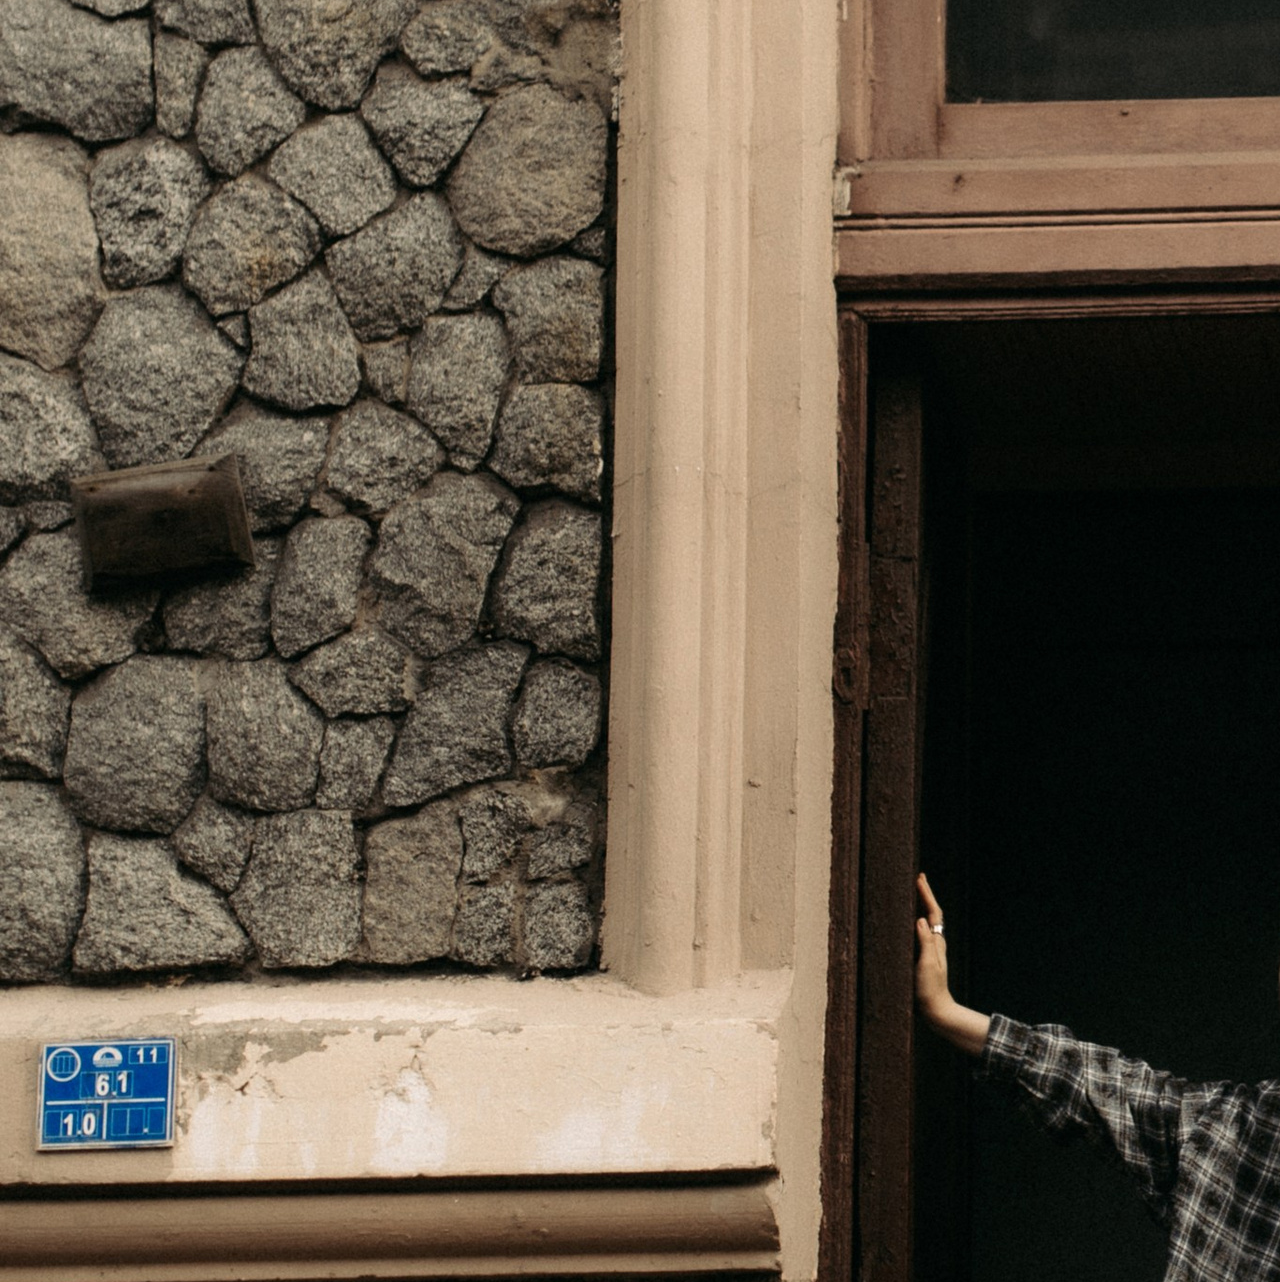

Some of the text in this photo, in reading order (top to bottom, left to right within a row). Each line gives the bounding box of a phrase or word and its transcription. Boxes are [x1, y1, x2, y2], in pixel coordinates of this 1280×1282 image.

[136, 1047, 158, 1064] 11
[95, 1071, 129, 1096] 6.1
[63, 1113, 97, 1136] 1.0
